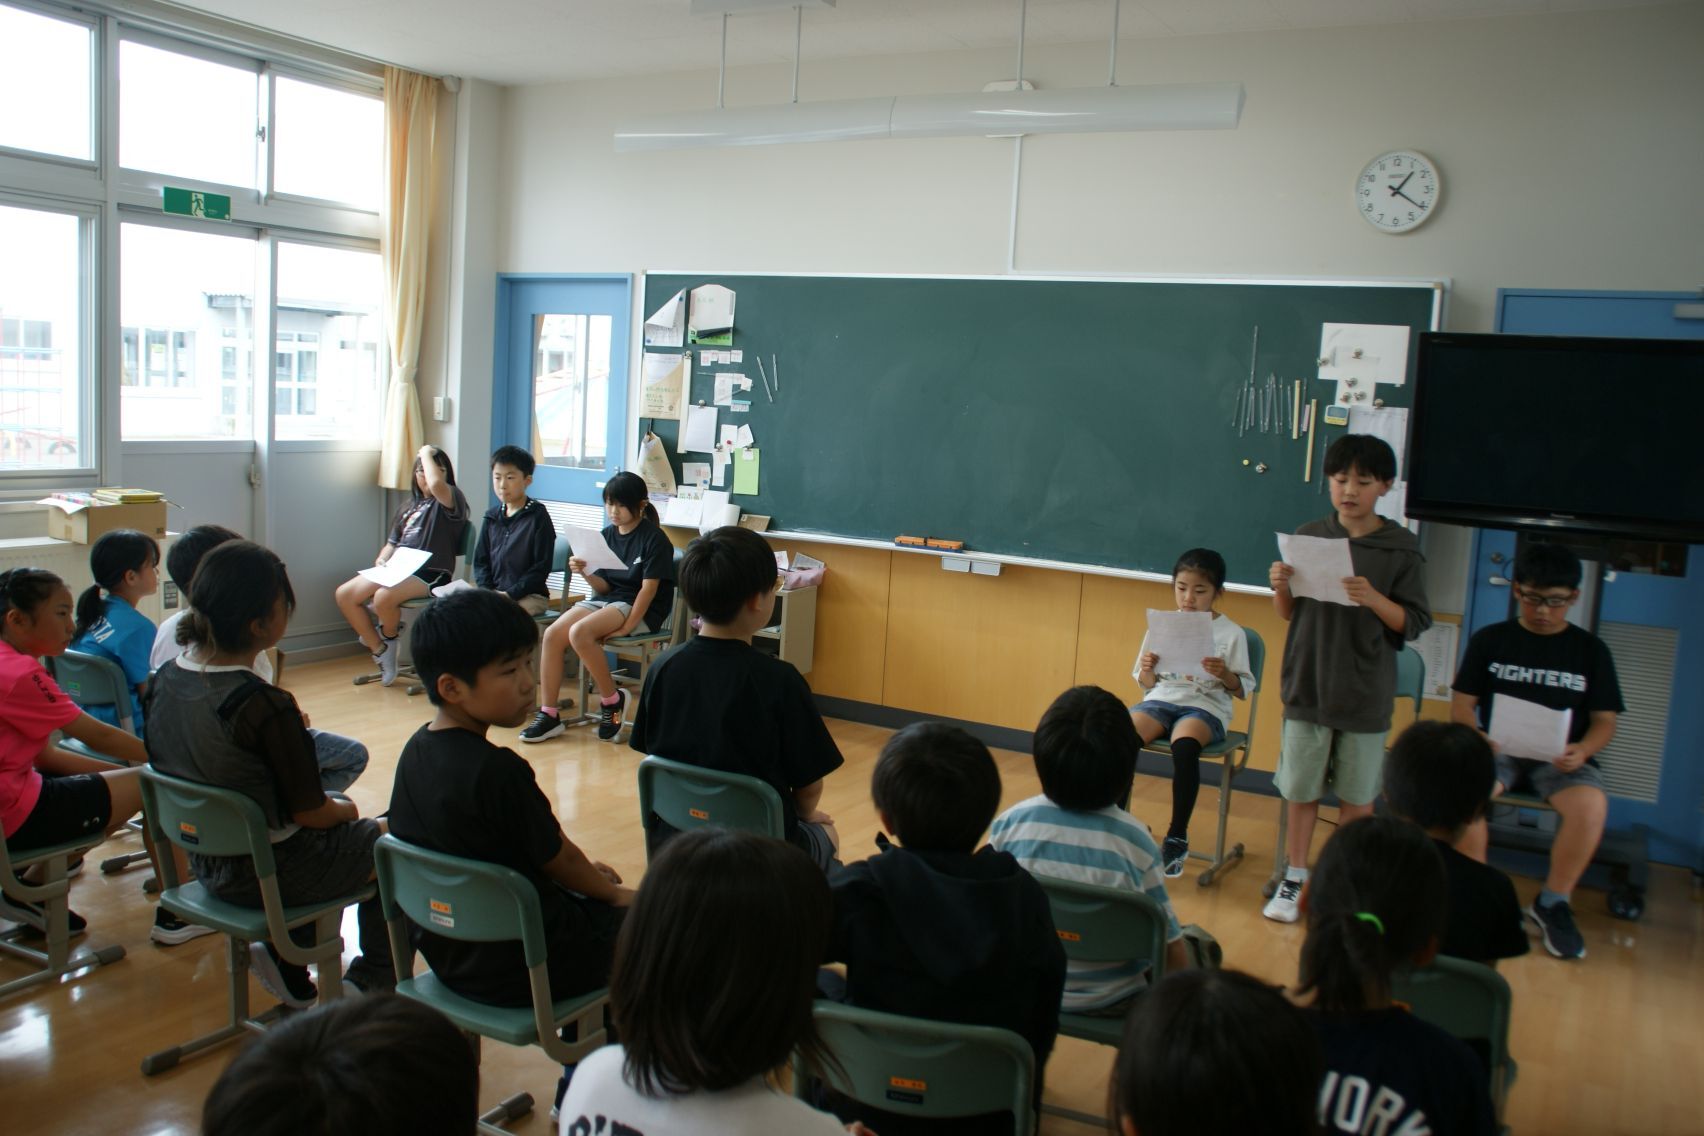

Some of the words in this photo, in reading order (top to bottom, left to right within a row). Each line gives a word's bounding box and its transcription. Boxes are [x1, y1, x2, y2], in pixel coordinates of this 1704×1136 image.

[1394, 158, 1401, 166] 12
[1380, 163, 1386, 171] 11
[1368, 174, 1376, 183] 10
[1420, 170, 1427, 179] 2
[1364, 189, 1370, 197] 9
[1424, 185, 1429, 194] 3
[1368, 202, 1374, 212] 8
[1378, 213, 1385, 221] 7
[1408, 211, 1415, 221] 5
[1487, 661, 1587, 692] FIGHTERS
